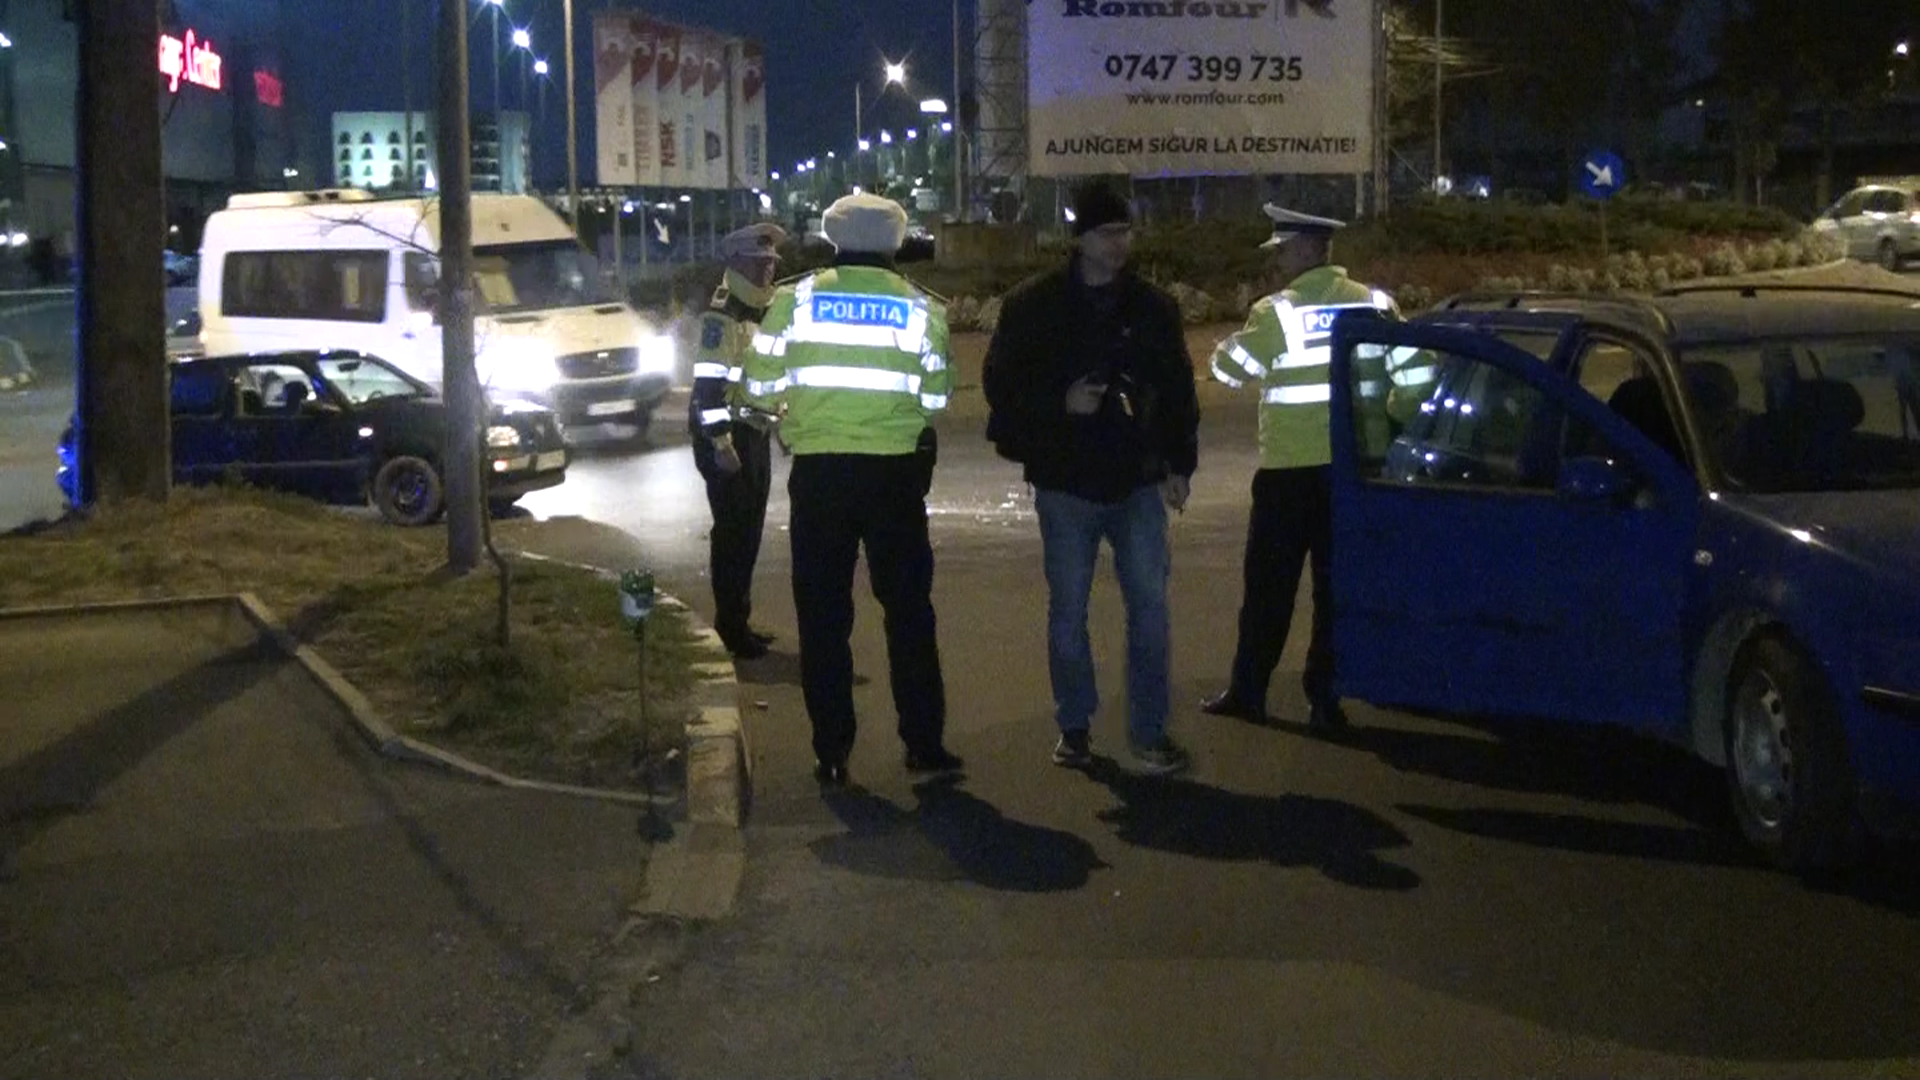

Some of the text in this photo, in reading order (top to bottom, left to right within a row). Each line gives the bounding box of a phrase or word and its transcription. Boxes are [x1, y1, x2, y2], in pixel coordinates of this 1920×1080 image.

[1105, 54, 1303, 82] 0747 399 735
[1126, 92, 1284, 106] www.romfour.com
[1045, 137, 1144, 155] AJUNGEM
[1148, 137, 1208, 154] SIGUR
[1213, 137, 1238, 154] LA
[817, 300, 903, 325] POLITIA
[1304, 312, 1335, 332] PO
